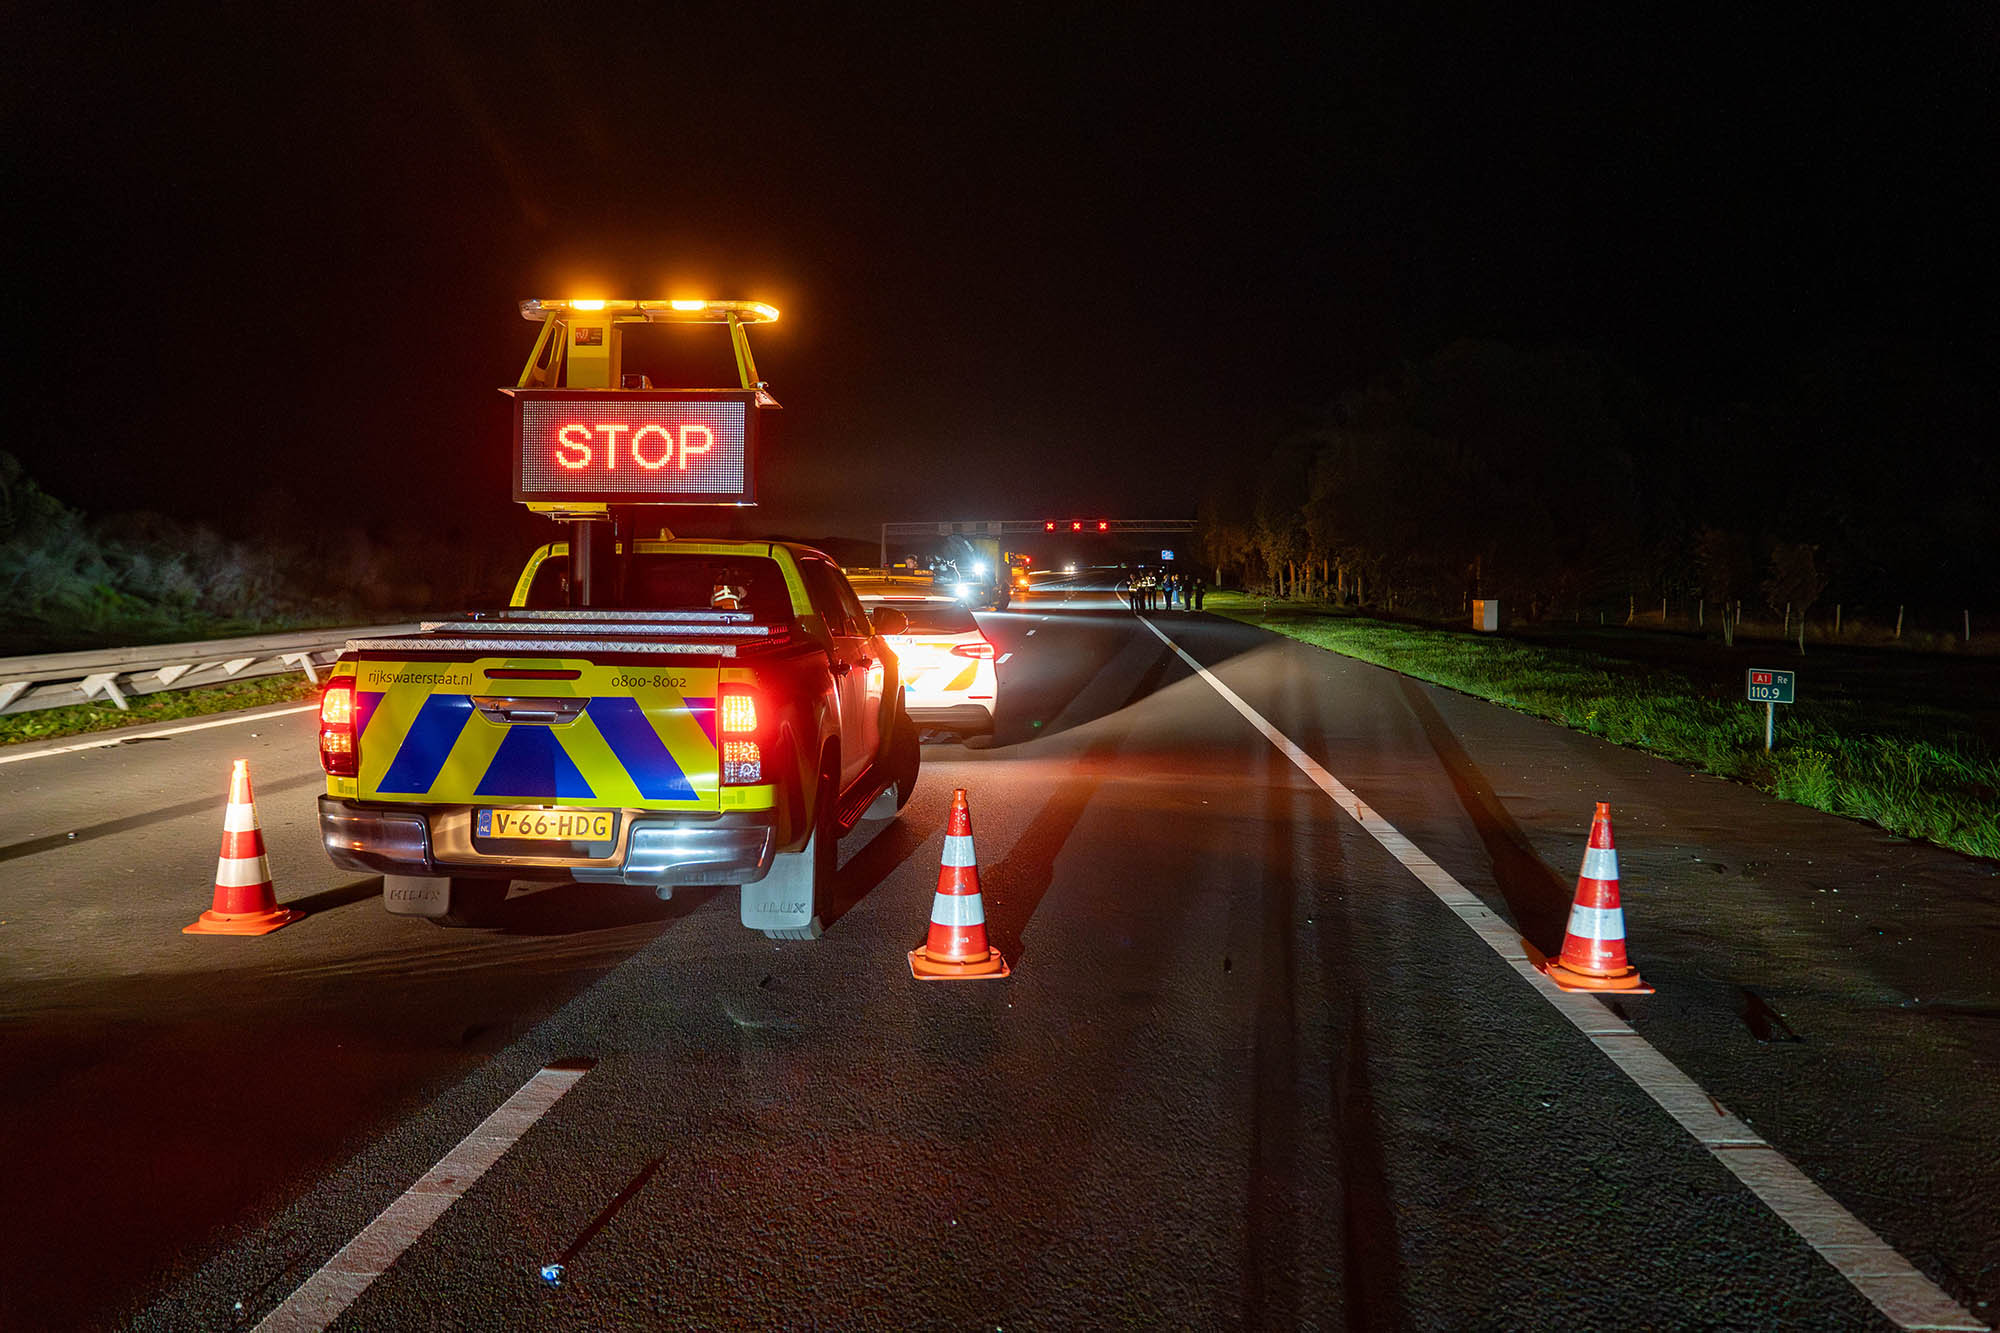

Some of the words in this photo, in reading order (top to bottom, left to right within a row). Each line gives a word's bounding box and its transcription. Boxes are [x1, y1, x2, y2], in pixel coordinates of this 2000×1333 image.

[556, 424, 713, 469] STOP
[368, 670, 473, 685] rijkswaterstaat.nl
[611, 674, 687, 688] 0800-8002
[1756, 674, 1768, 682] A1
[1777, 675, 1788, 684] Re
[1752, 687, 1780, 699] 110.9
[496, 813, 606, 836] V-66-HDG
